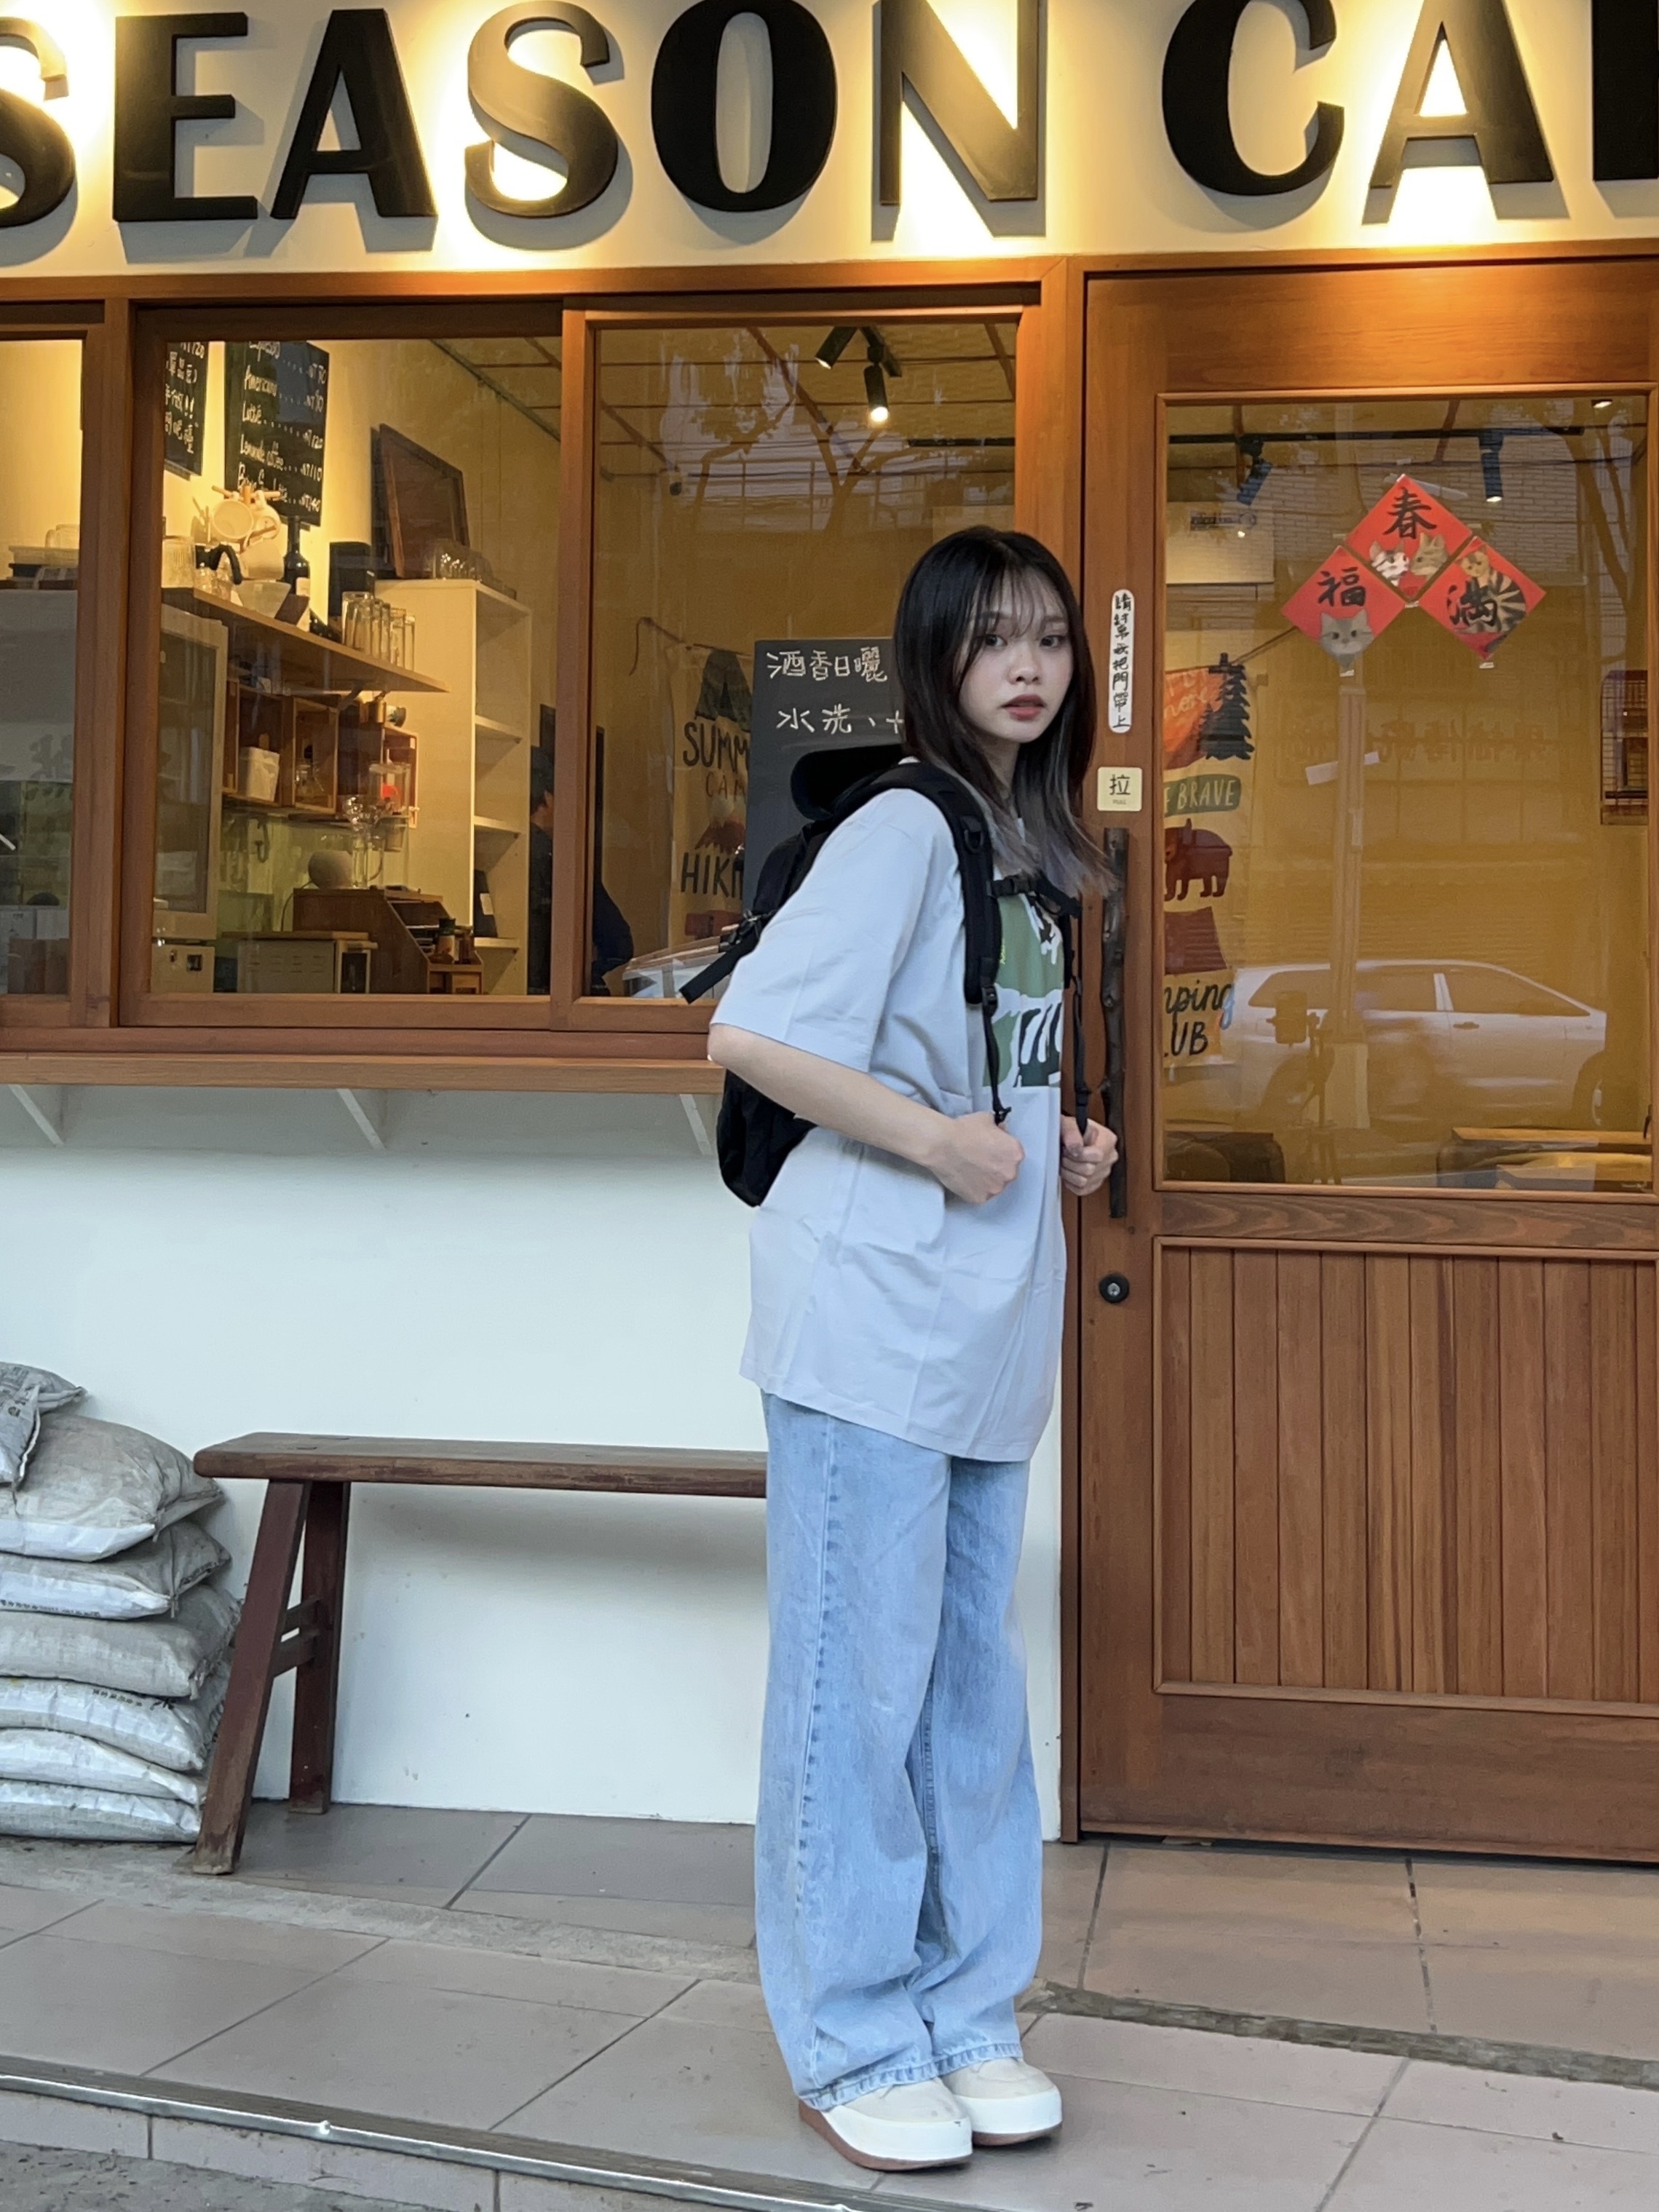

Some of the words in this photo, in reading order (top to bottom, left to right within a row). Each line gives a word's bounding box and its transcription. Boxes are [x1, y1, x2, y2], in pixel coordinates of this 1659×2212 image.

[1162, 0, 1659, 195] CA
[1382, 486, 1437, 539] 春
[1318, 566, 1366, 607] 福
[767, 646, 888, 683] 酒香日曬
[1109, 774, 1131, 796] 拉
[1177, 780, 1237, 811] BRAVE
[1163, 1021, 1208, 1058] UB
